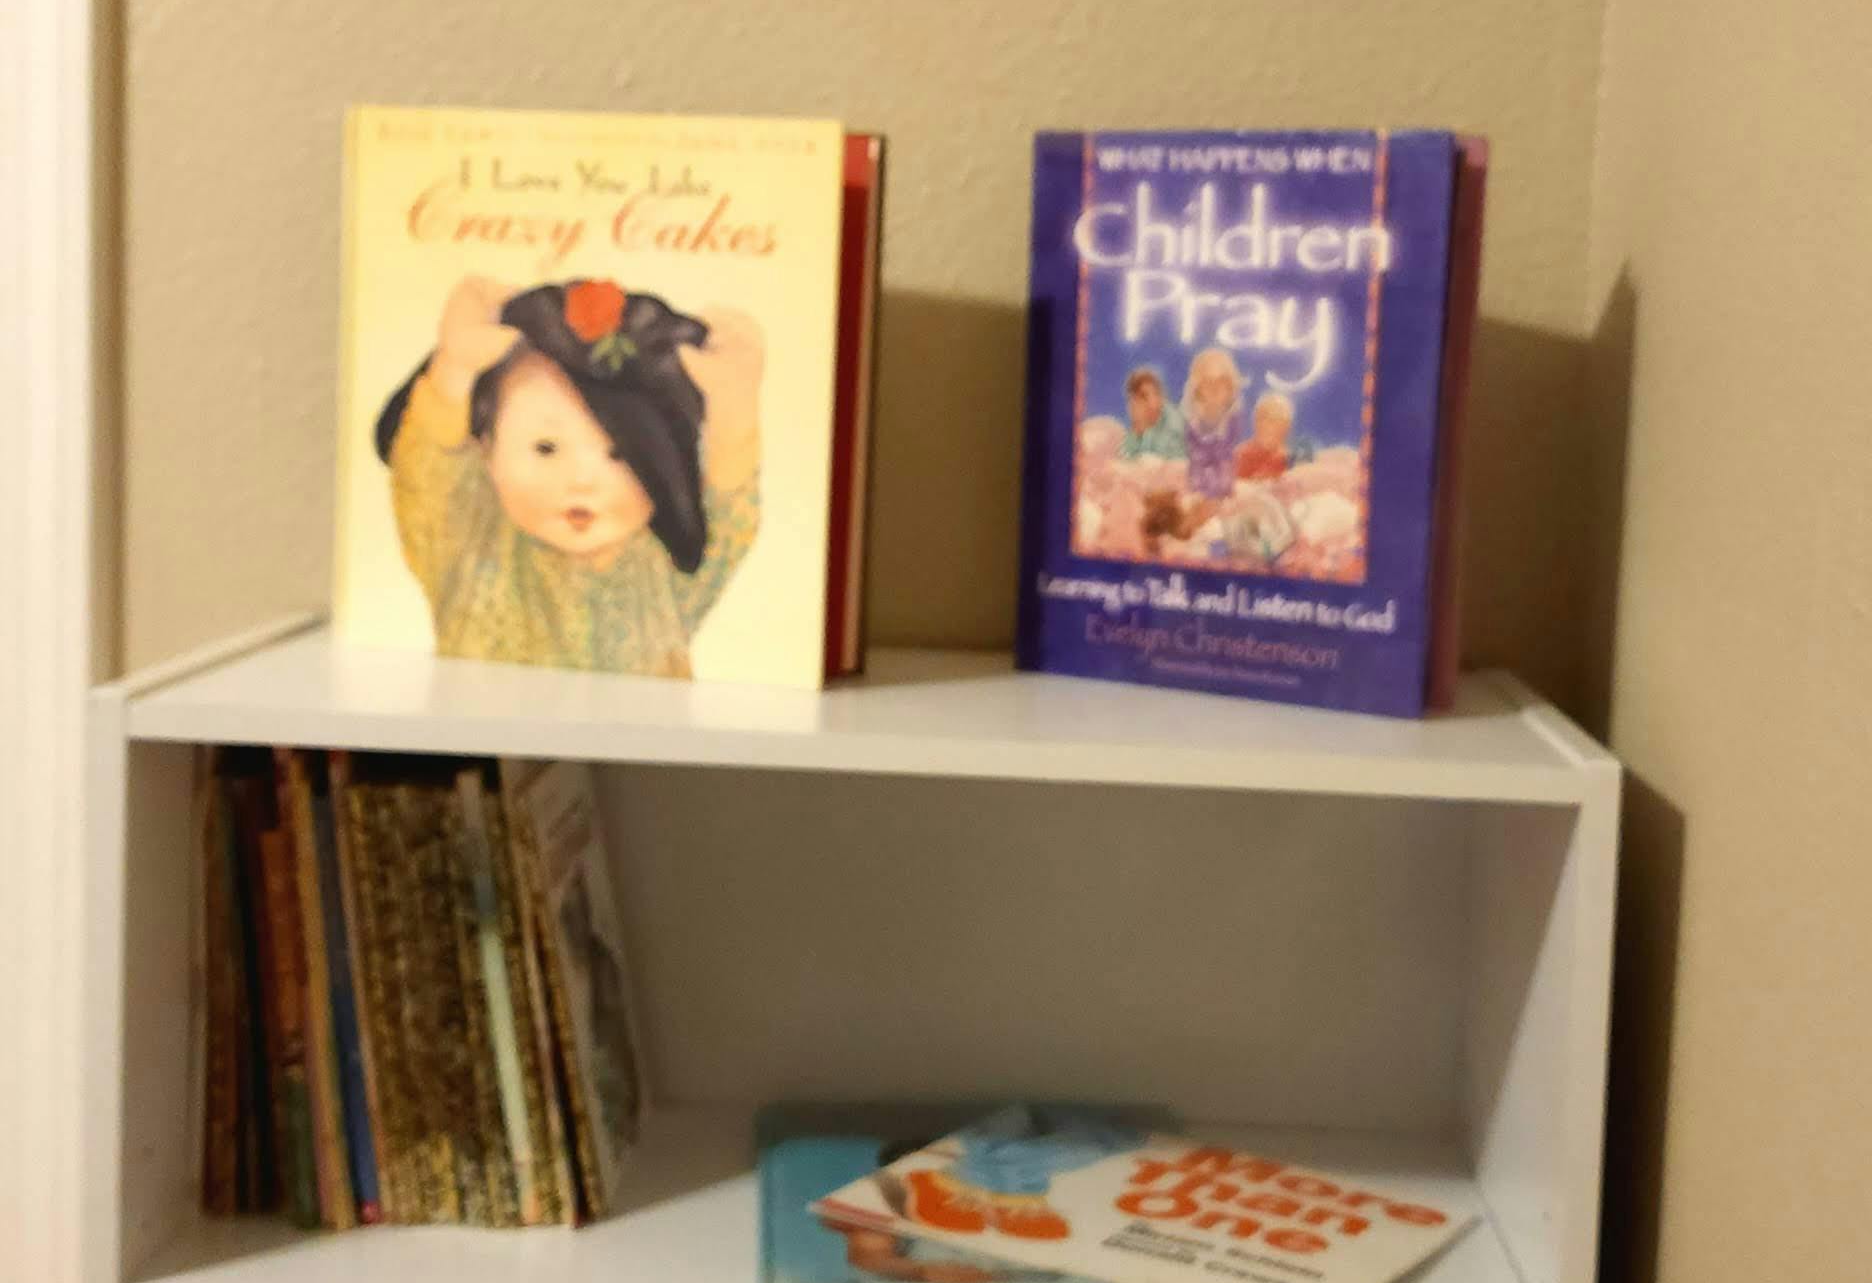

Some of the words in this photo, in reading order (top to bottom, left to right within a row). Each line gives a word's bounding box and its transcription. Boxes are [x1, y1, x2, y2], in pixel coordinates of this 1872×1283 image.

[1098, 147, 1164, 172] WHAT
[1168, 147, 1290, 175] HAPPENS
[1294, 148, 1374, 176] WHEN
[406, 176, 587, 274] Crazy
[611, 188, 777, 257] Cakes
[1073, 180, 1394, 275] Children
[1123, 268, 1336, 394] Pray
[1144, 571, 1190, 612] Talk
[1191, 583, 1237, 616] and
[1237, 587, 1313, 624] Listen
[1314, 602, 1343, 629] to
[1342, 599, 1396, 634] God
[1173, 613, 1340, 669] Christenson
[1113, 1190, 1331, 1254] One
[1129, 1159, 1372, 1238] Than
[1174, 1146, 1448, 1228] More
